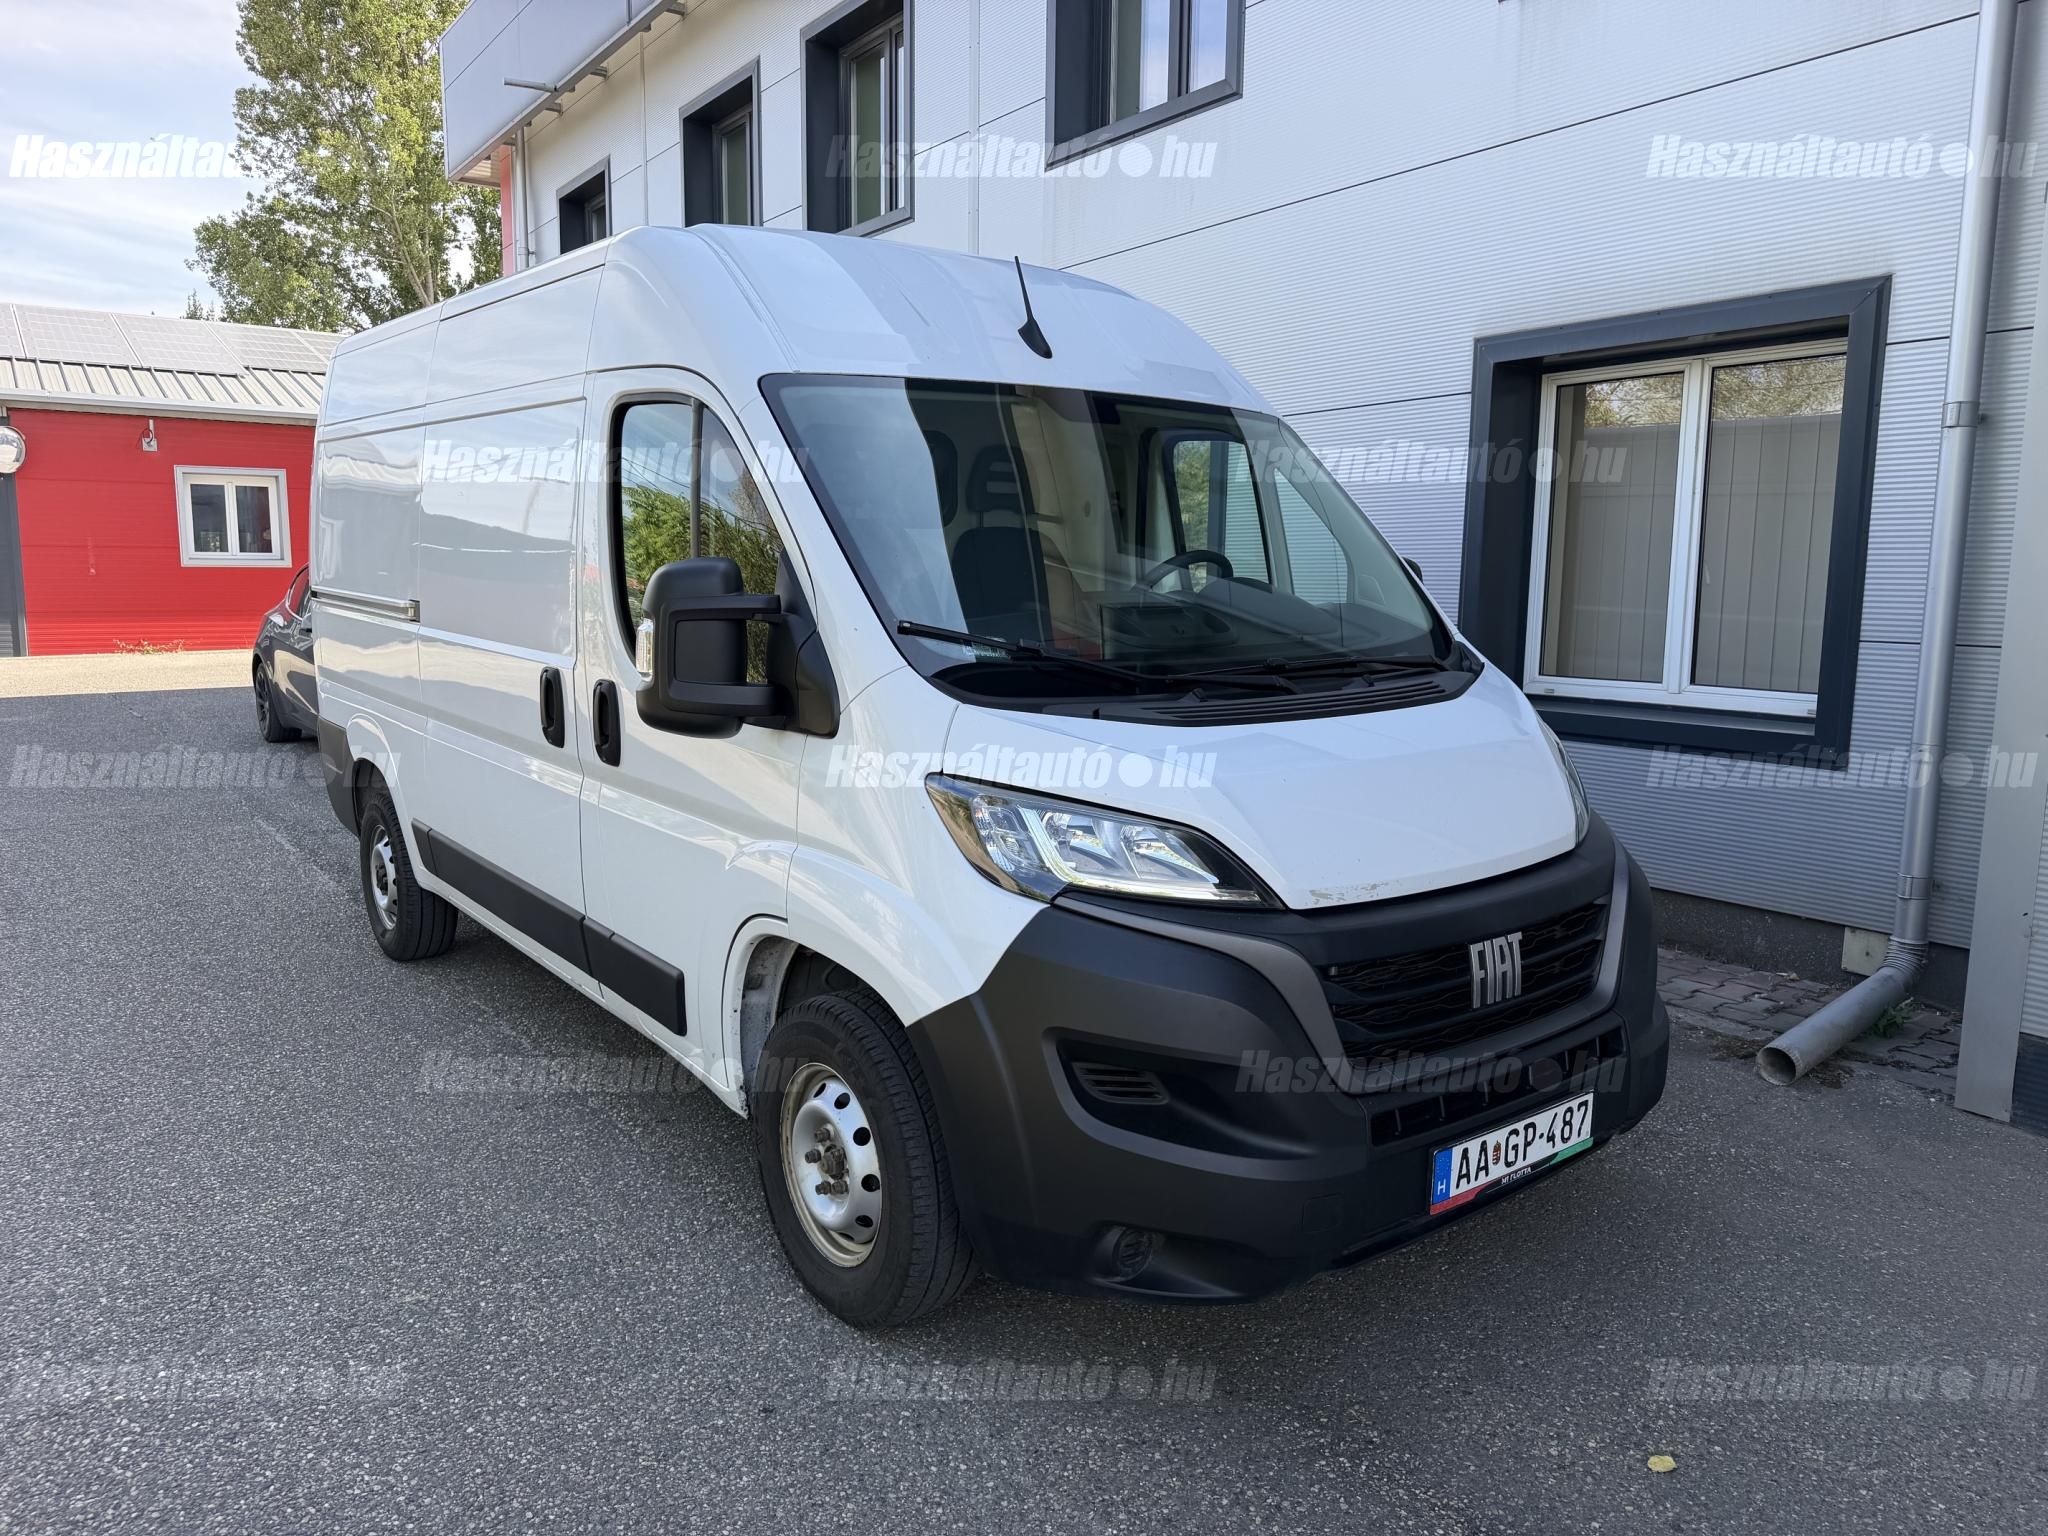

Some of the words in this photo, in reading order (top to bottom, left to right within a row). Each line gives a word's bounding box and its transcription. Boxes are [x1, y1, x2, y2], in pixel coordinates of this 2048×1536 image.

[1469, 931, 1523, 1009] FIAT
[1437, 1179, 1447, 1196] H
[1455, 1139, 1490, 1190] AA
